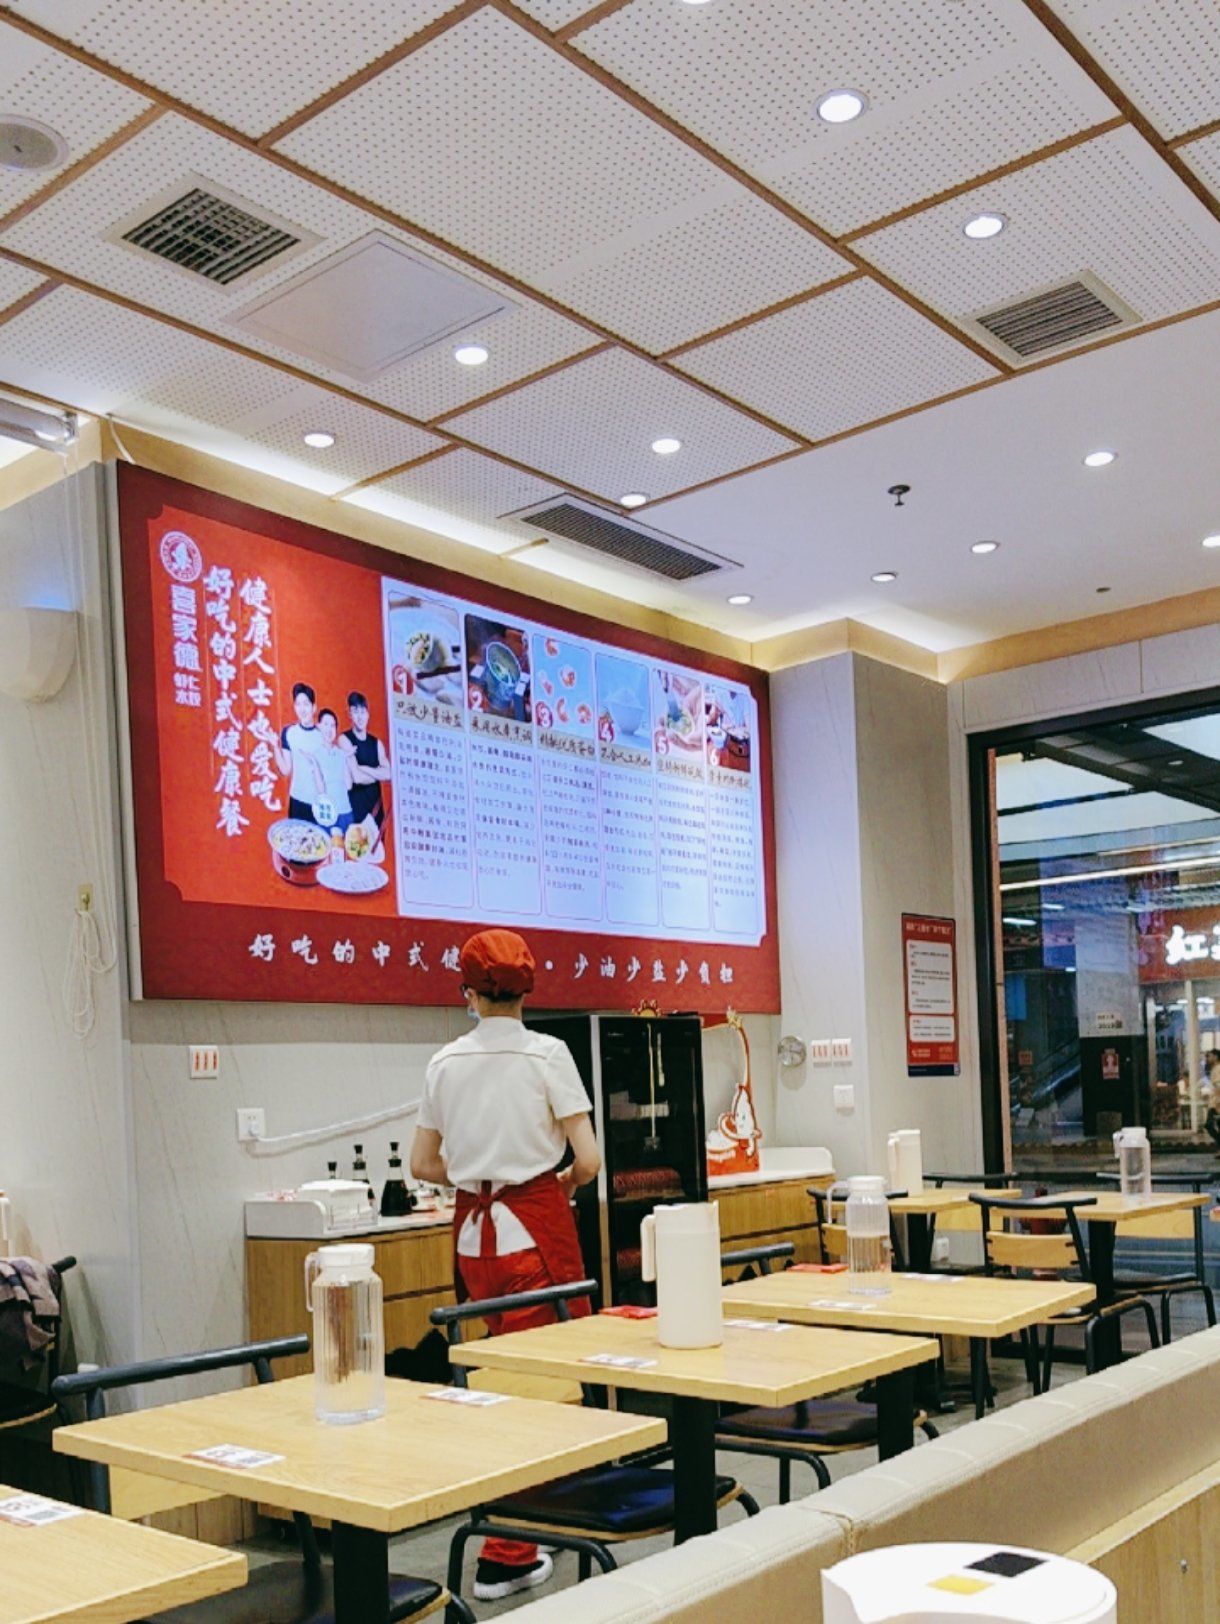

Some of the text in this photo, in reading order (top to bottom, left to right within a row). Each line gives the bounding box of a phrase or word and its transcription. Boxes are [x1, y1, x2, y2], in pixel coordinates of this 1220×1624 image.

[203, 565, 250, 837] 好吃的中式健康餐
[240, 577, 283, 812] 健康人士也爱吃
[249, 934, 462, 972] 好吃的中式健
